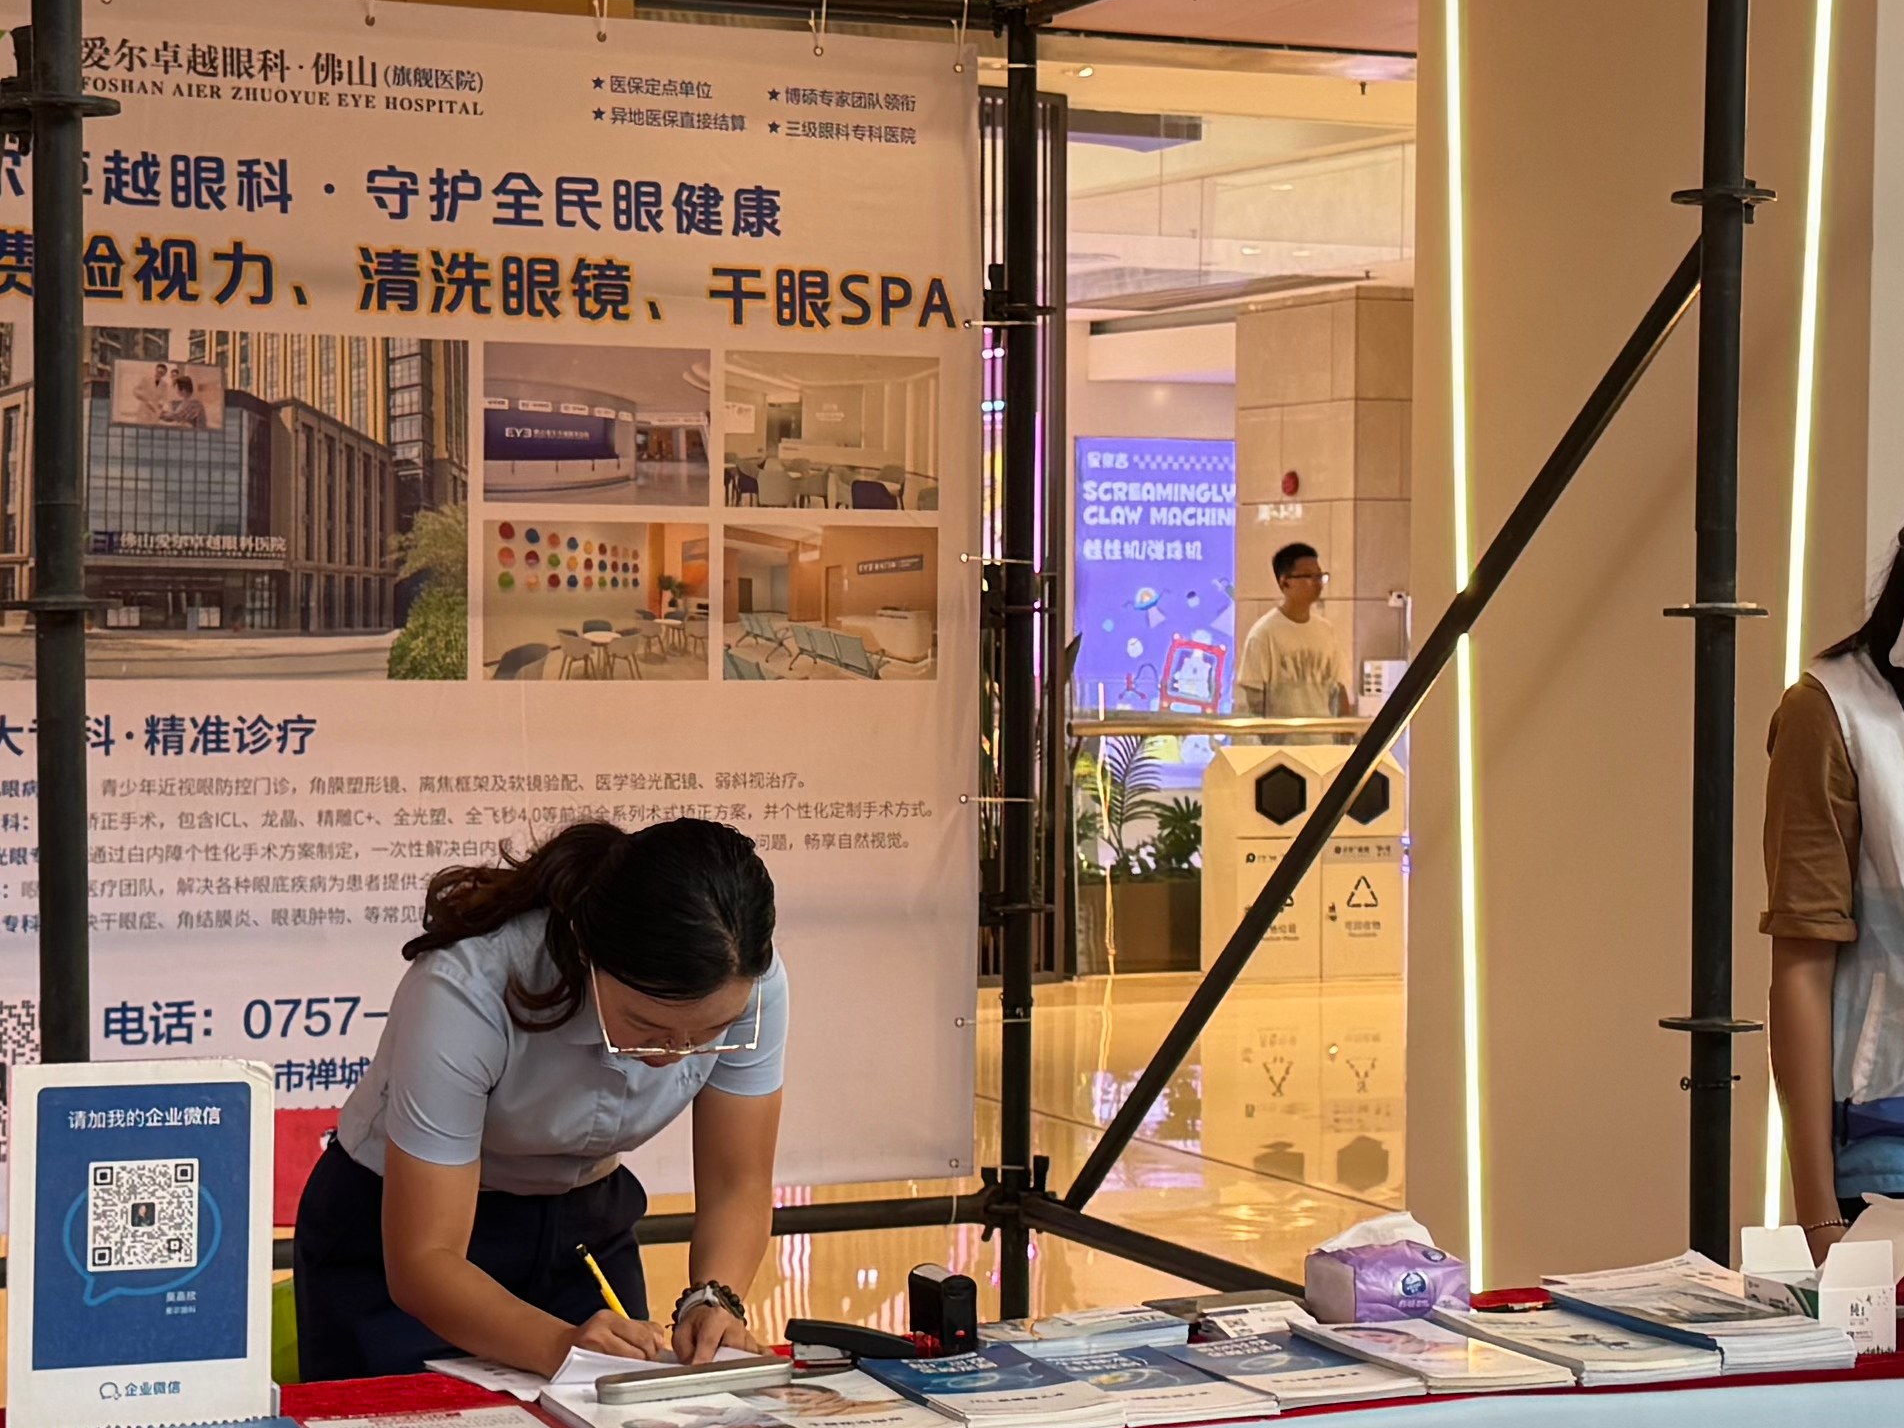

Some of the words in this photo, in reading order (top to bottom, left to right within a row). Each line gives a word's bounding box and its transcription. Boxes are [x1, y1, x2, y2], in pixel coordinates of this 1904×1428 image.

[81, 75, 165, 97] FOSHAN
[172, 81, 222, 100] AIER
[230, 85, 330, 107] ZHUOYUE
[337, 91, 376, 110] EYE
[384, 95, 485, 117] HOSPITAL
[609, 74, 713, 100] 医保定点单位
[784, 86, 917, 113] 博硕专家团队领衔
[610, 106, 747, 133] 异地医保直接结算
[785, 119, 917, 145] 三级眼科专科医院
[1082, 504, 1143, 526] CLAW
[68, 1106, 222, 1131] 请加我的企业微信
[124, 1380, 182, 1398] 企业微信
